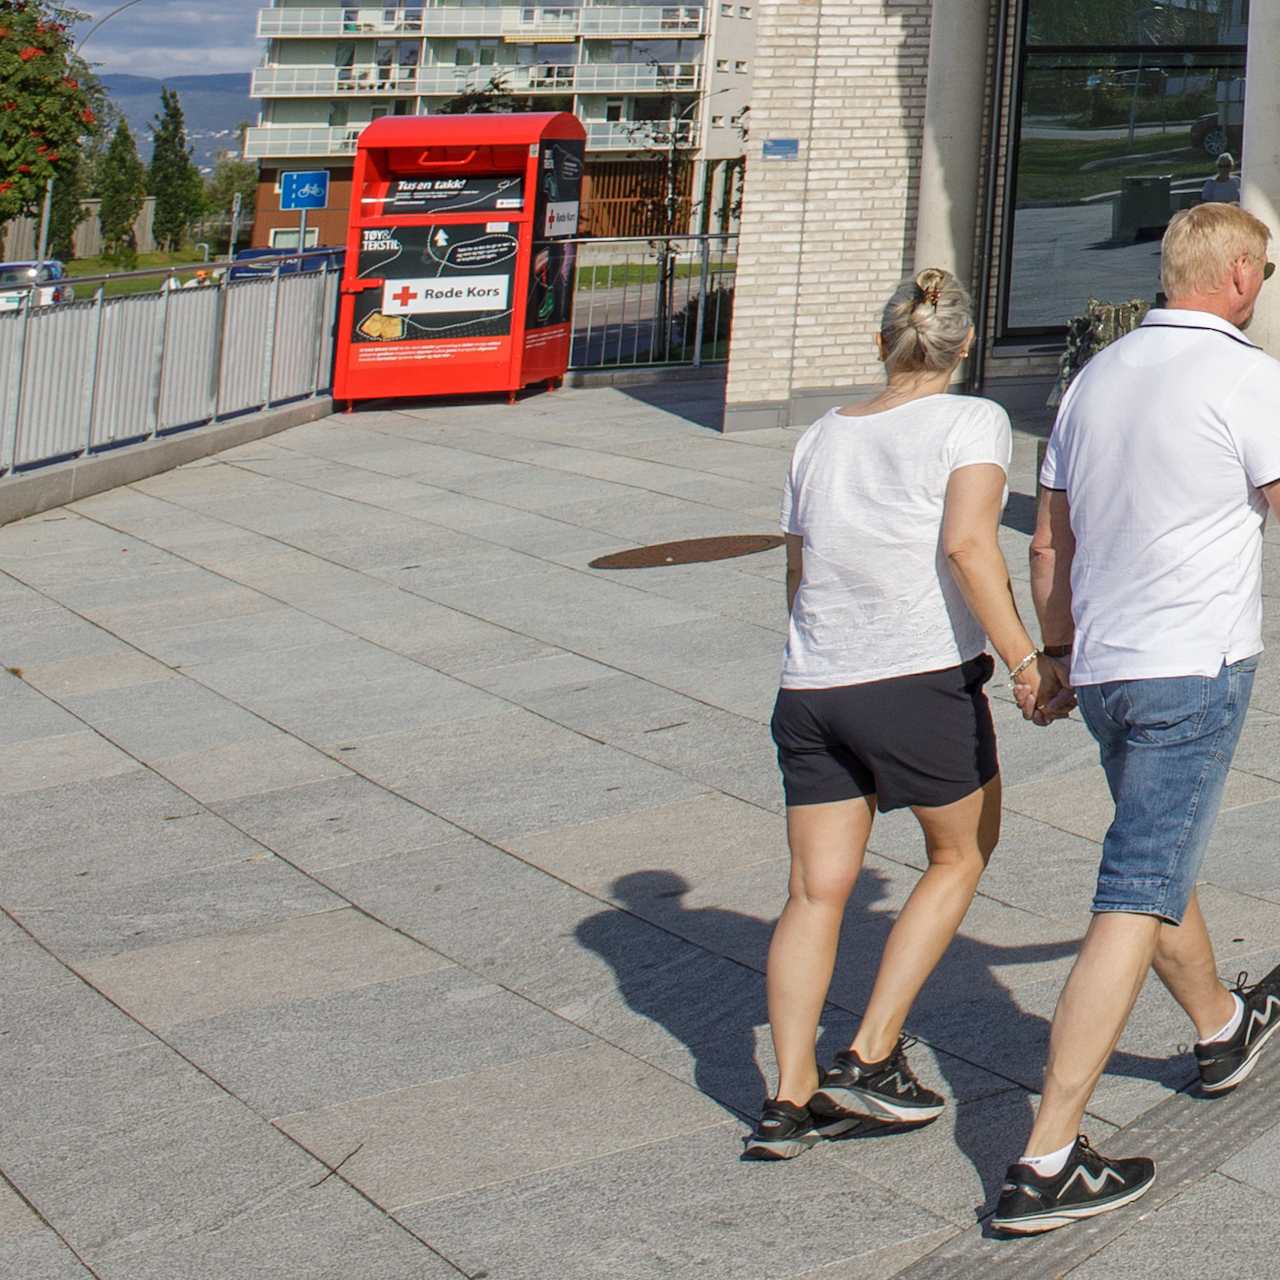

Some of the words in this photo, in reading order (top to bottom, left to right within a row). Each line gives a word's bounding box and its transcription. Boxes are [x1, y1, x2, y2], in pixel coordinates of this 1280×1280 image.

[398, 180, 432, 190] Tusen
[362, 230, 391, 241] TØY&
[362, 240, 400, 251] TEKSTIL
[425, 288, 463, 299] Røde
[467, 287, 500, 298] Kors
